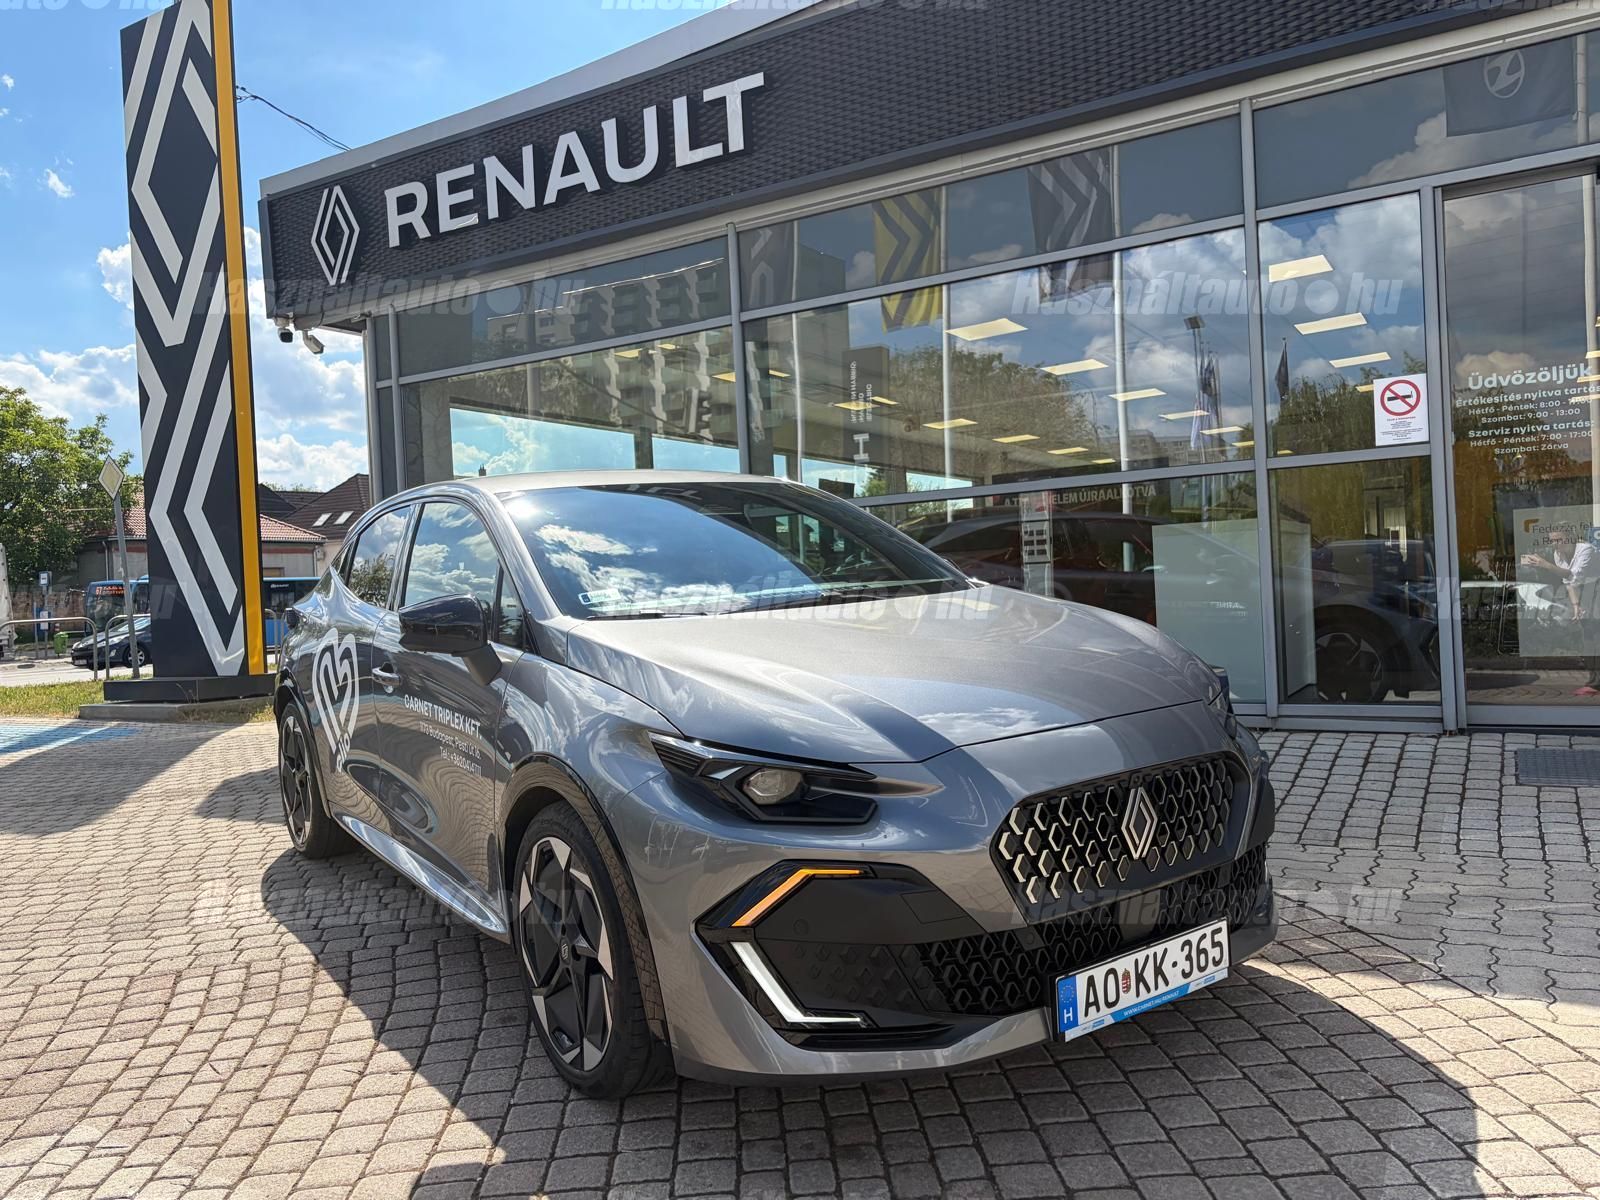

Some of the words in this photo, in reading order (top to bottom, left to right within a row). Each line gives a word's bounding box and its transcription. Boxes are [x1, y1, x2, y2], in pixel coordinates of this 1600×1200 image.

[384, 71, 764, 248] RENAULT
[1468, 363, 1592, 390] Üdvözöljük
[1455, 393, 1522, 408] Értékesítés
[1524, 389, 1561, 401] nyitva
[1468, 406, 1495, 416] Hétfő
[1502, 403, 1538, 412] Péntek:
[1539, 400, 1561, 408] 8:00
[1481, 413, 1526, 424] Szombat:
[1527, 411, 1549, 419] 9:00
[1555, 408, 1580, 417] 13:00
[1468, 427, 1511, 438] Szerviz
[1513, 424, 1551, 435] nyitva
[1470, 439, 1497, 448] Hétfő
[1503, 436, 1539, 444] Péntek:
[1541, 433, 1562, 441] 7:00
[1569, 430, 1593, 439] 17:00
[1494, 444, 1539, 455] Szombat:
[1541, 442, 1569, 451] Zárva
[404, 694, 433, 718] CARNET
[434, 704, 465, 732] TRIPLEX
[465, 716, 482, 740] KFT.
[1084, 967, 1120, 1018] AO
[1063, 1006, 1073, 1024] H
